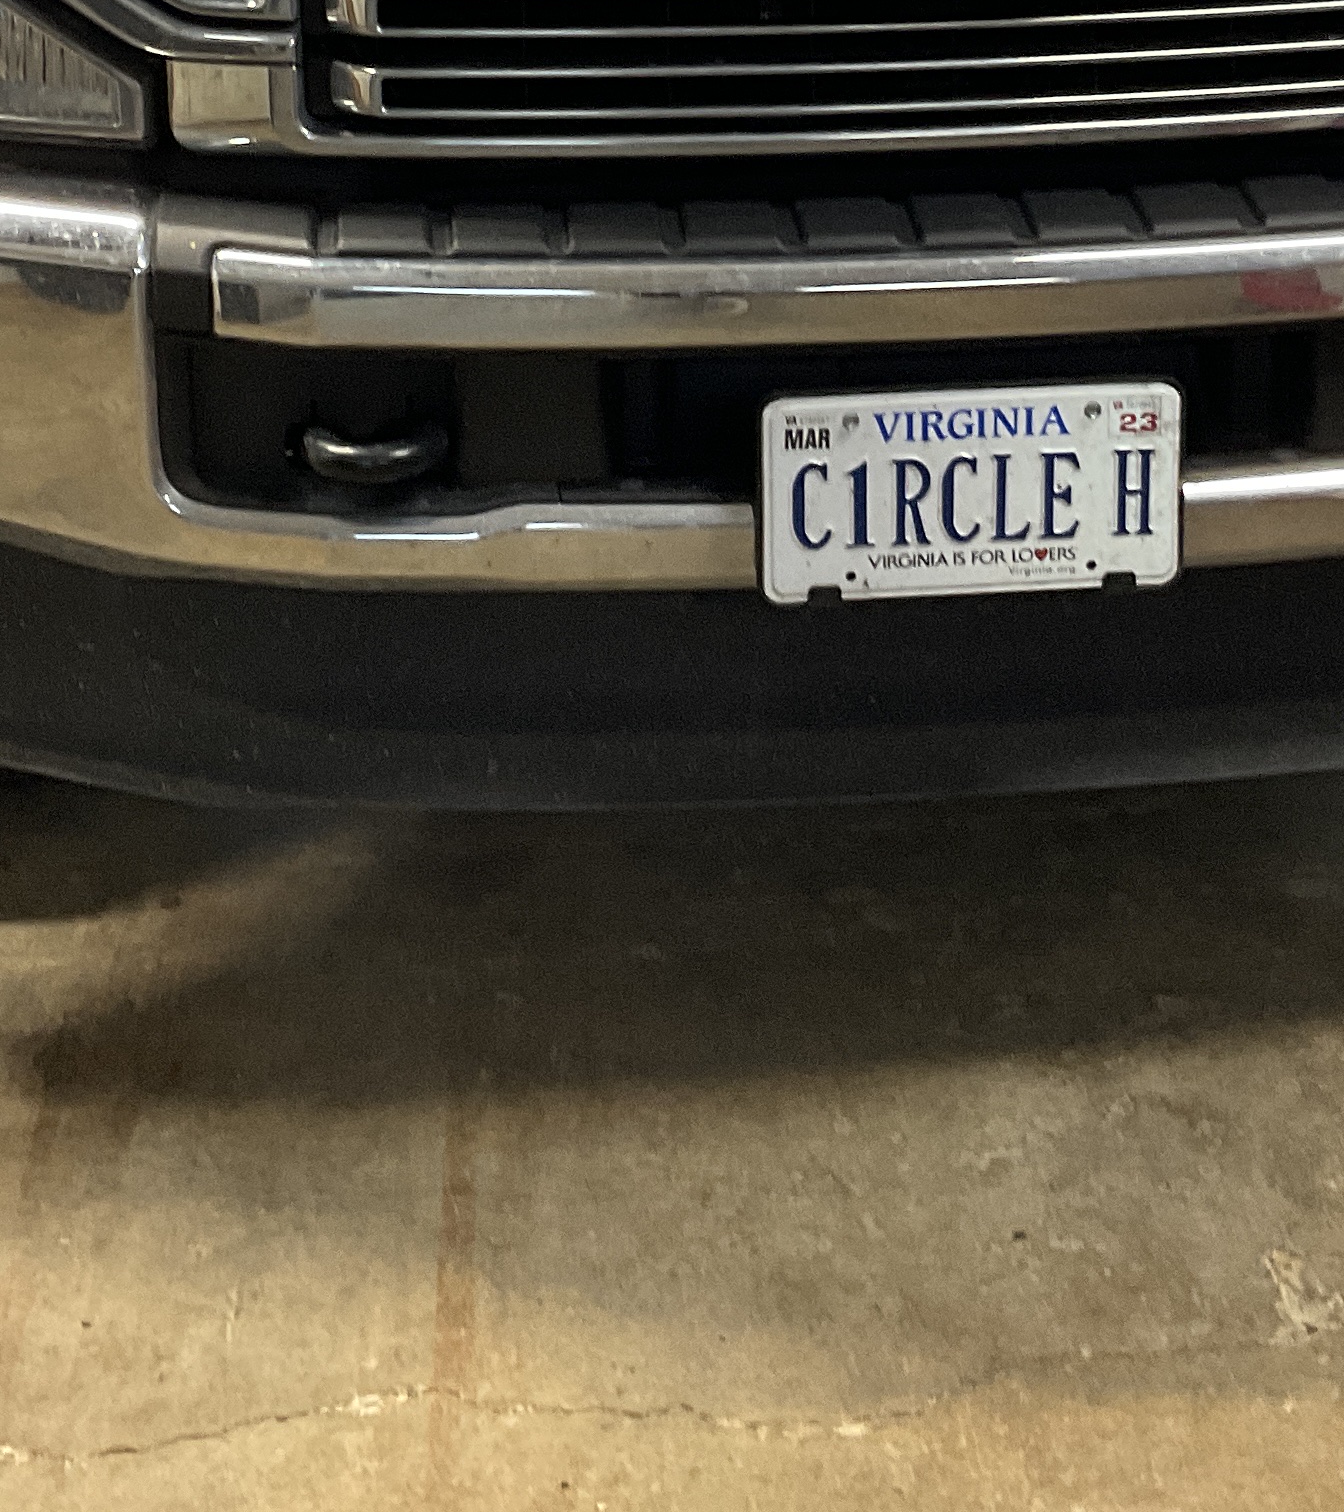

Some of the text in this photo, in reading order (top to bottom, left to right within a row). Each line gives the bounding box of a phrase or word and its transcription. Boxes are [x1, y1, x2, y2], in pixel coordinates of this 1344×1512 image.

[873, 405, 1070, 444] VIRGINIA
[1119, 413, 1158, 432] 23
[785, 428, 830, 450] MAR
[1112, 448, 1155, 537] H
[869, 552, 949, 570] VIRGINIA
[953, 551, 966, 566] IS
[971, 549, 1007, 566] FOR
